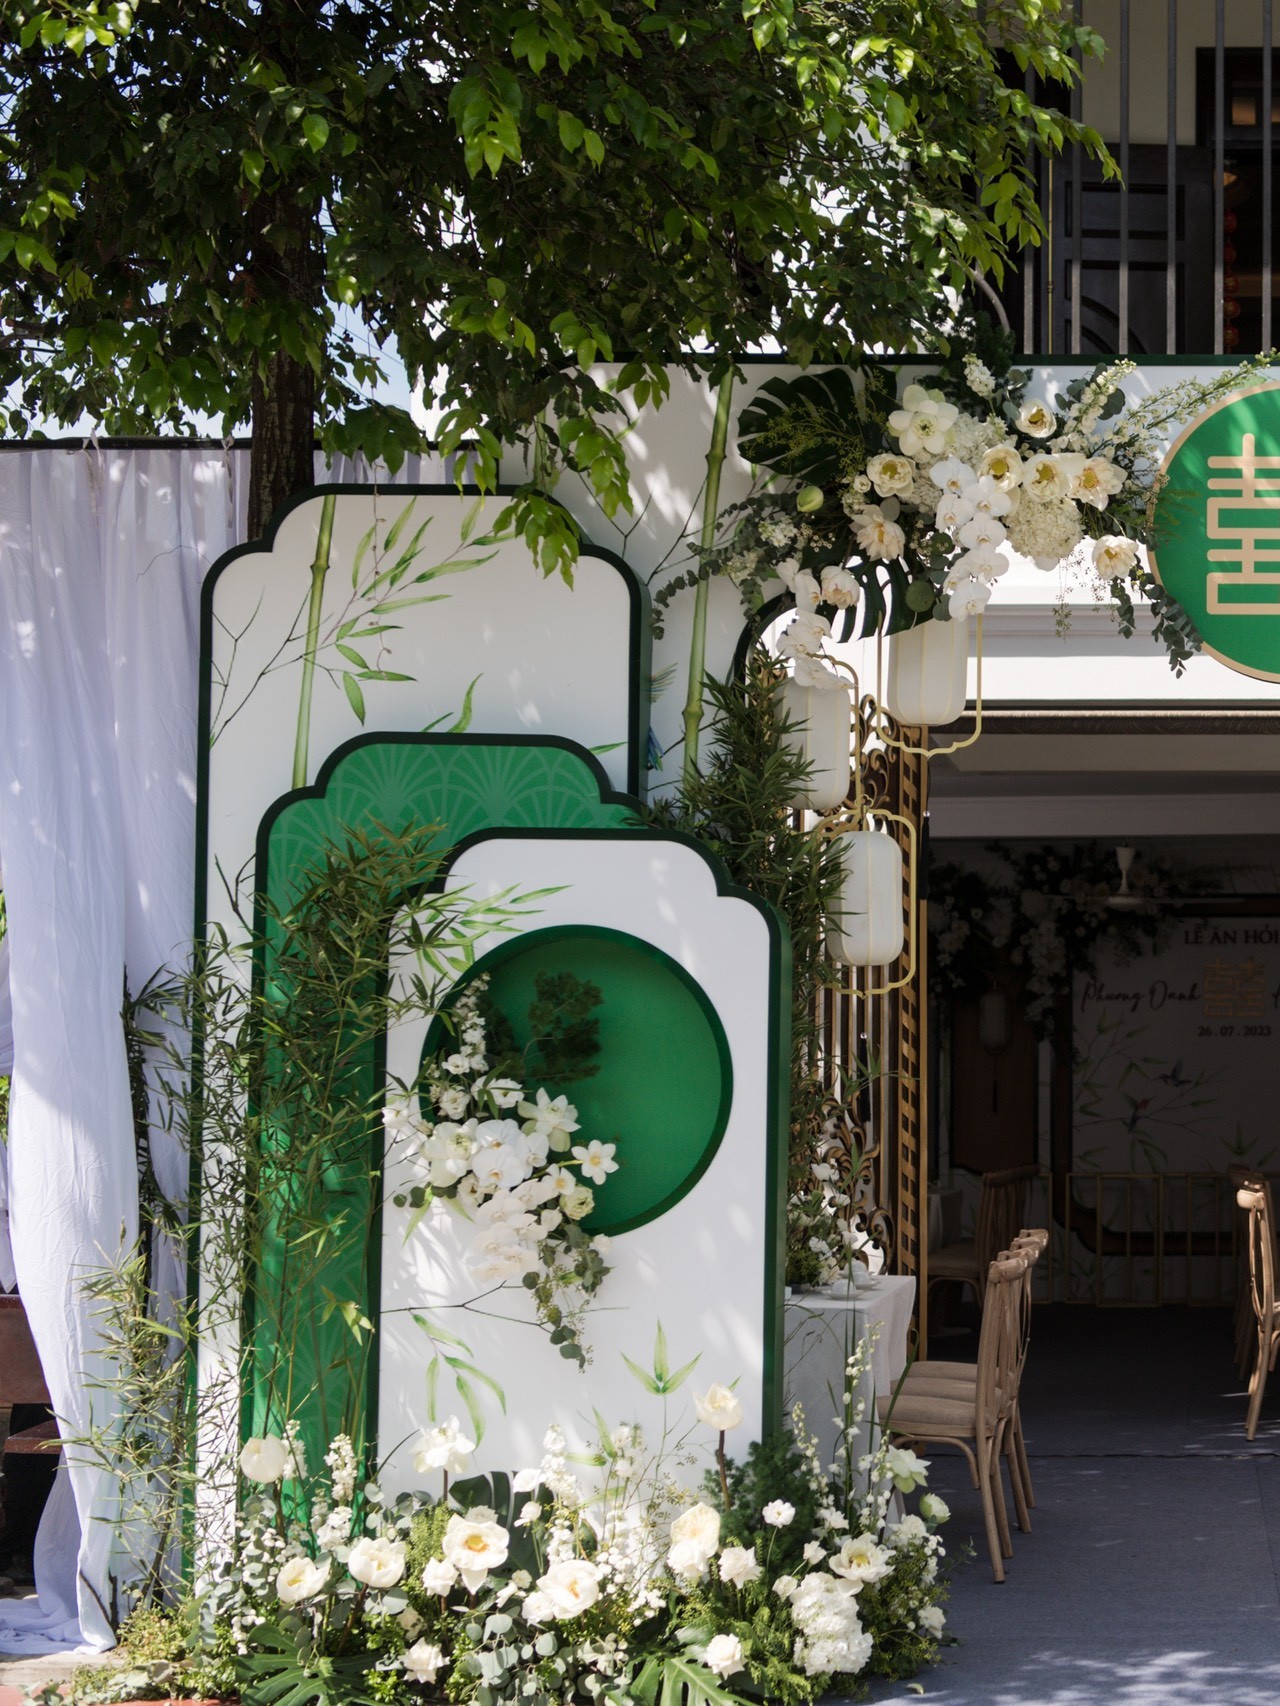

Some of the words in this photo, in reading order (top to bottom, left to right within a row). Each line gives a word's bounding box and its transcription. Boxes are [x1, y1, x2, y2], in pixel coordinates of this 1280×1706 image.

[1184, 923, 1205, 945] LỄ
[1210, 927, 1238, 945] ĂN
[1244, 924, 1280, 945] HỎI
